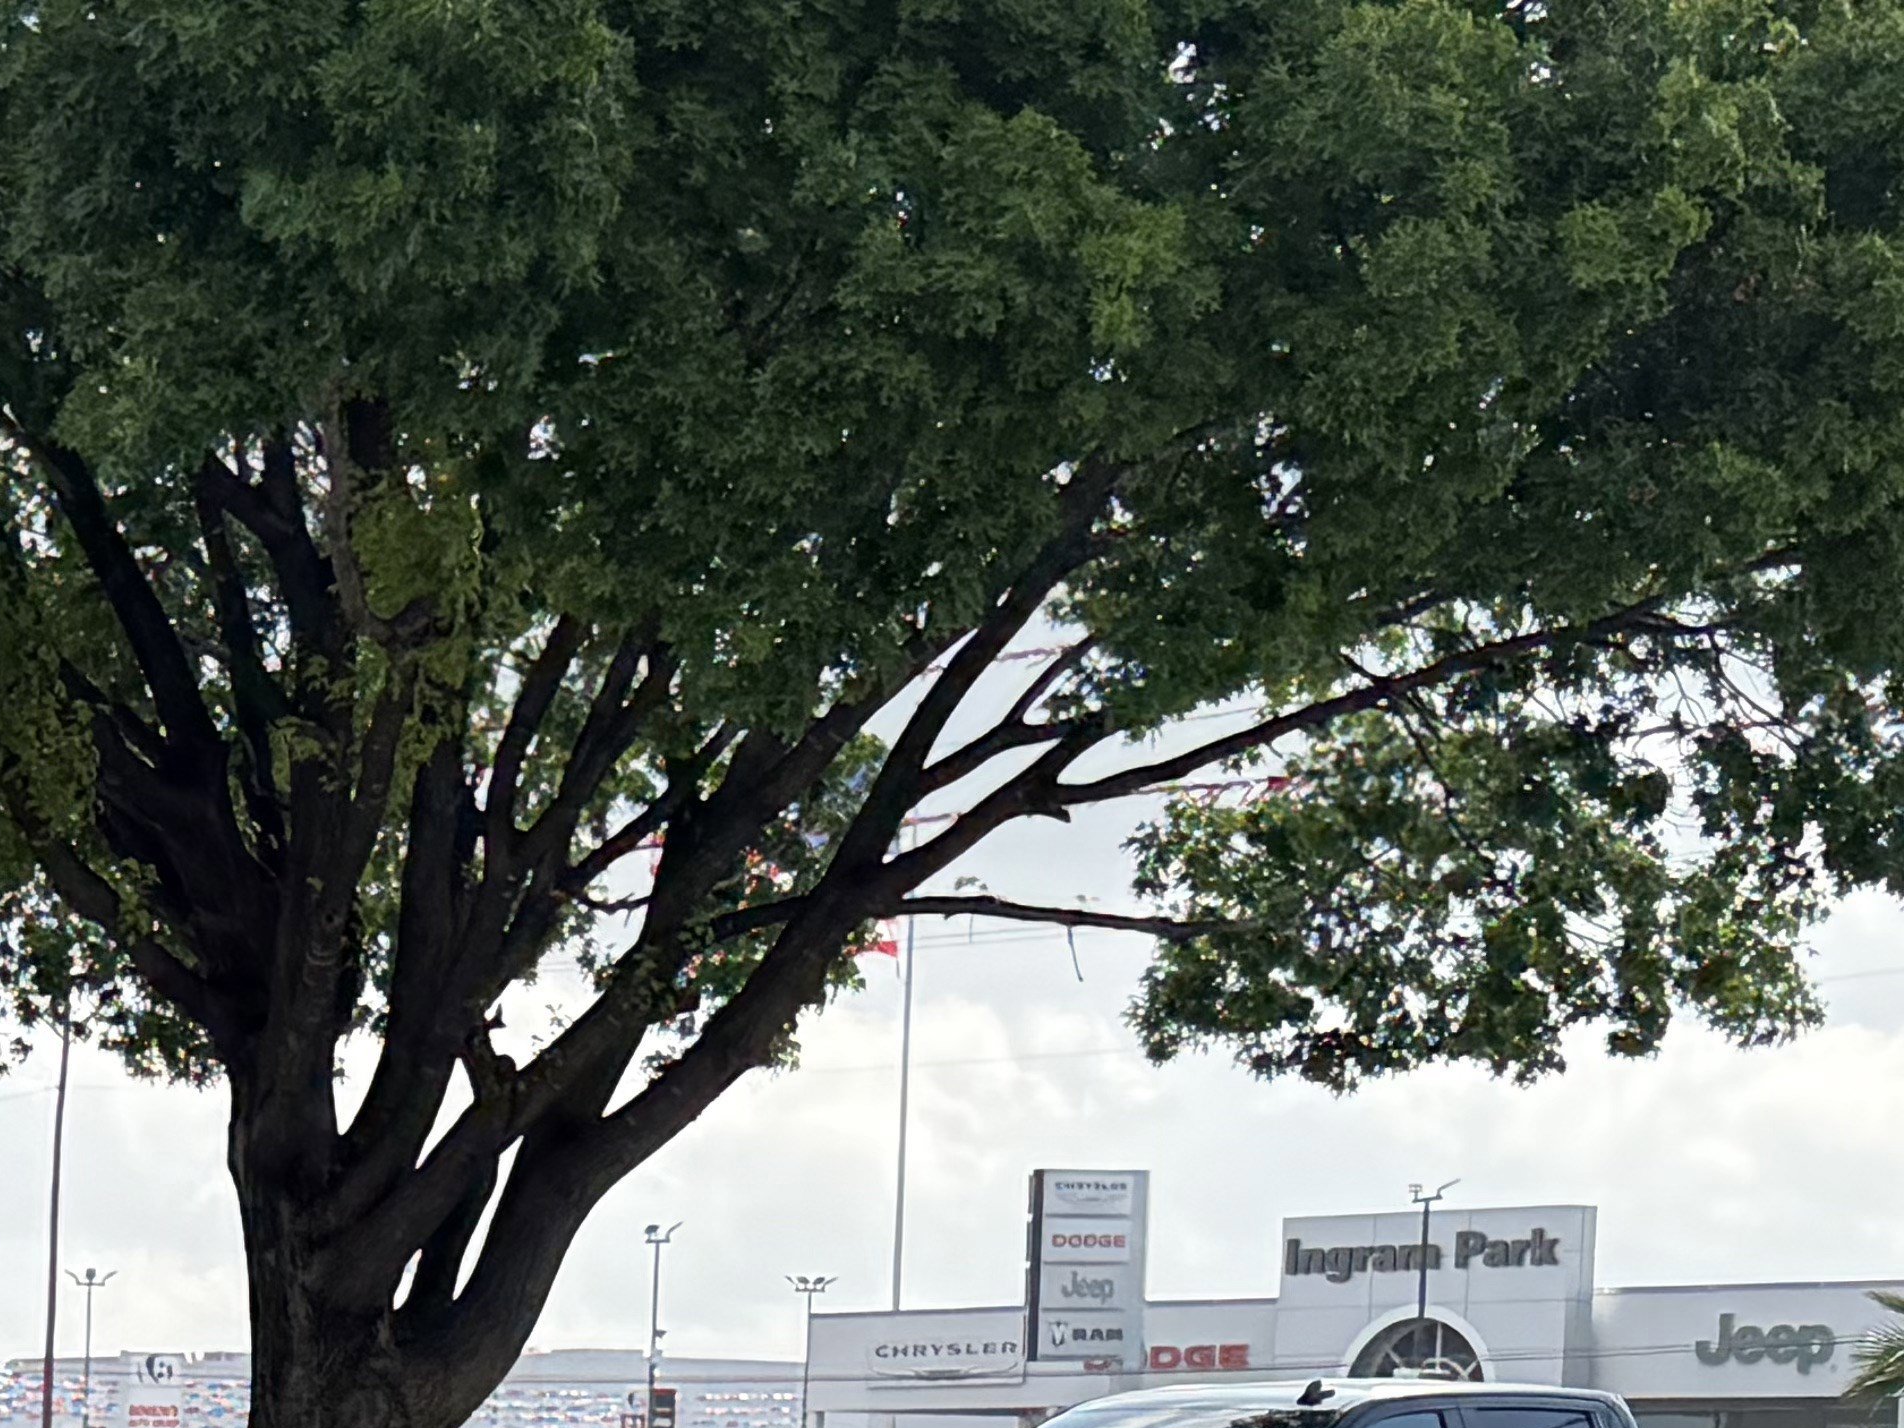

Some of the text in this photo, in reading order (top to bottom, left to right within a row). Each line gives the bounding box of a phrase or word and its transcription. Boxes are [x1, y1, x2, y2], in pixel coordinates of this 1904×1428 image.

[1052, 1234, 1126, 1249] DODGE
[1285, 1227, 1562, 1283] Ingram Park
[1061, 1270, 1114, 1304] Jeep
[1072, 1328, 1124, 1342] RAM
[1695, 1312, 1835, 1375] Jeep
[874, 1341, 1018, 1359] CHRYSLER
